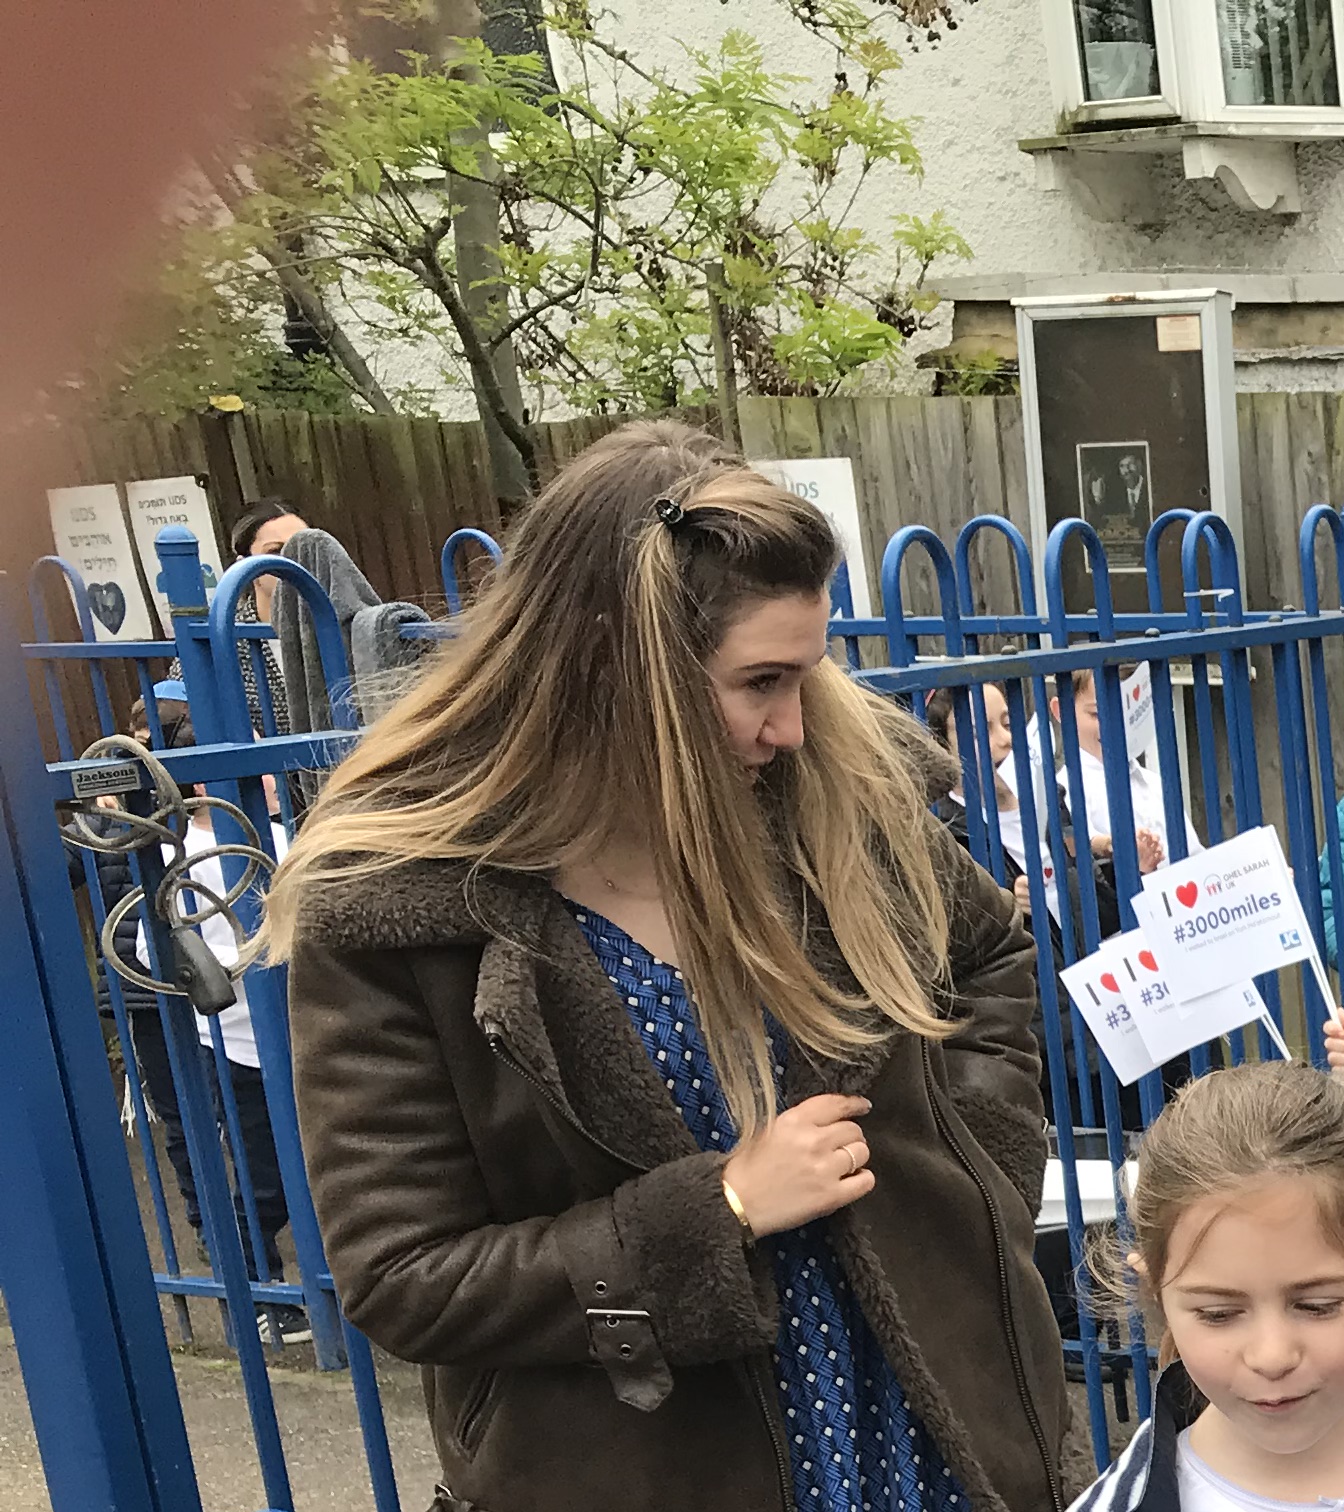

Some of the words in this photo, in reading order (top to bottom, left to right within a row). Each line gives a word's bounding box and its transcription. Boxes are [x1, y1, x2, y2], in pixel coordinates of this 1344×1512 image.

[77, 768, 136, 783] Jacksons
[1242, 859, 1270, 874] SARAH
[1173, 892, 1282, 944] #3000miles
